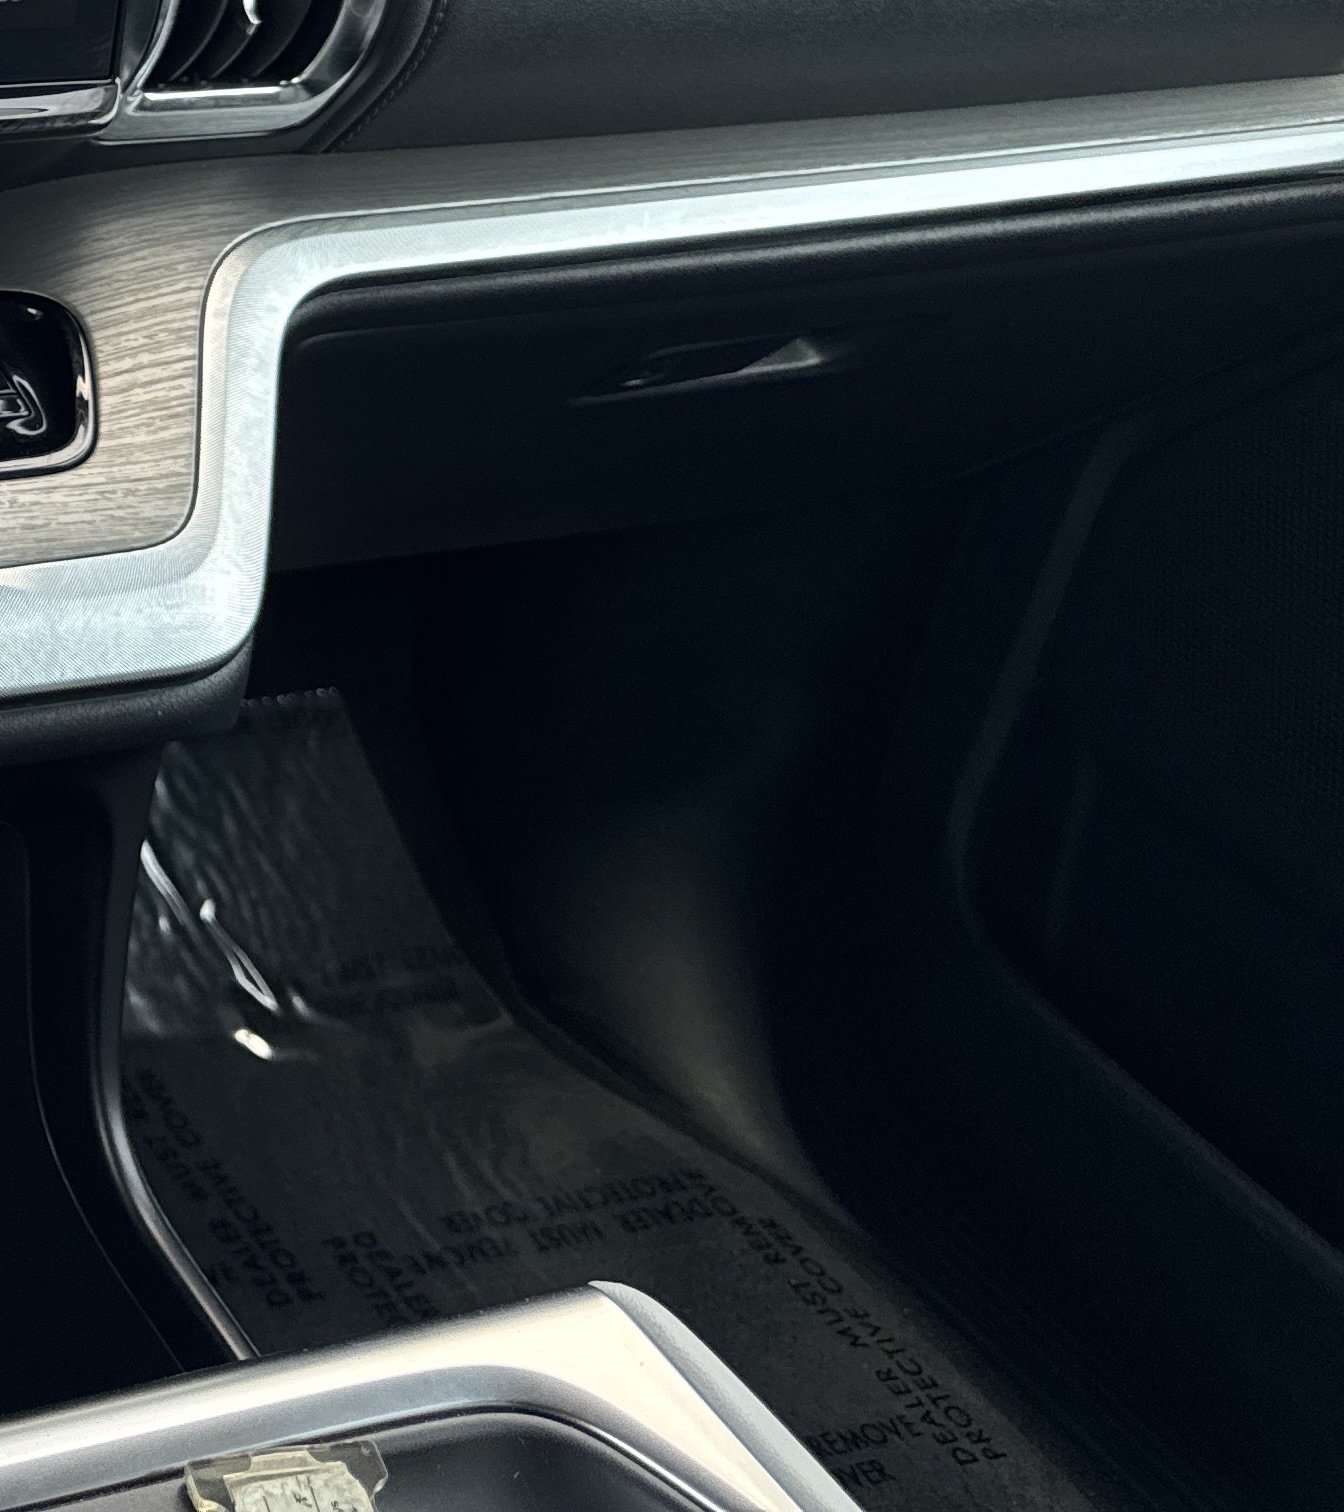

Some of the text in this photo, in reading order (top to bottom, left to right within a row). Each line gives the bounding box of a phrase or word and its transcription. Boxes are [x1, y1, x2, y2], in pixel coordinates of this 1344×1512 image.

[788, 1279, 870, 1349] MUST
[844, 1307, 1007, 1462] PROTECTIVE
[875, 1366, 980, 1467] DEALER
